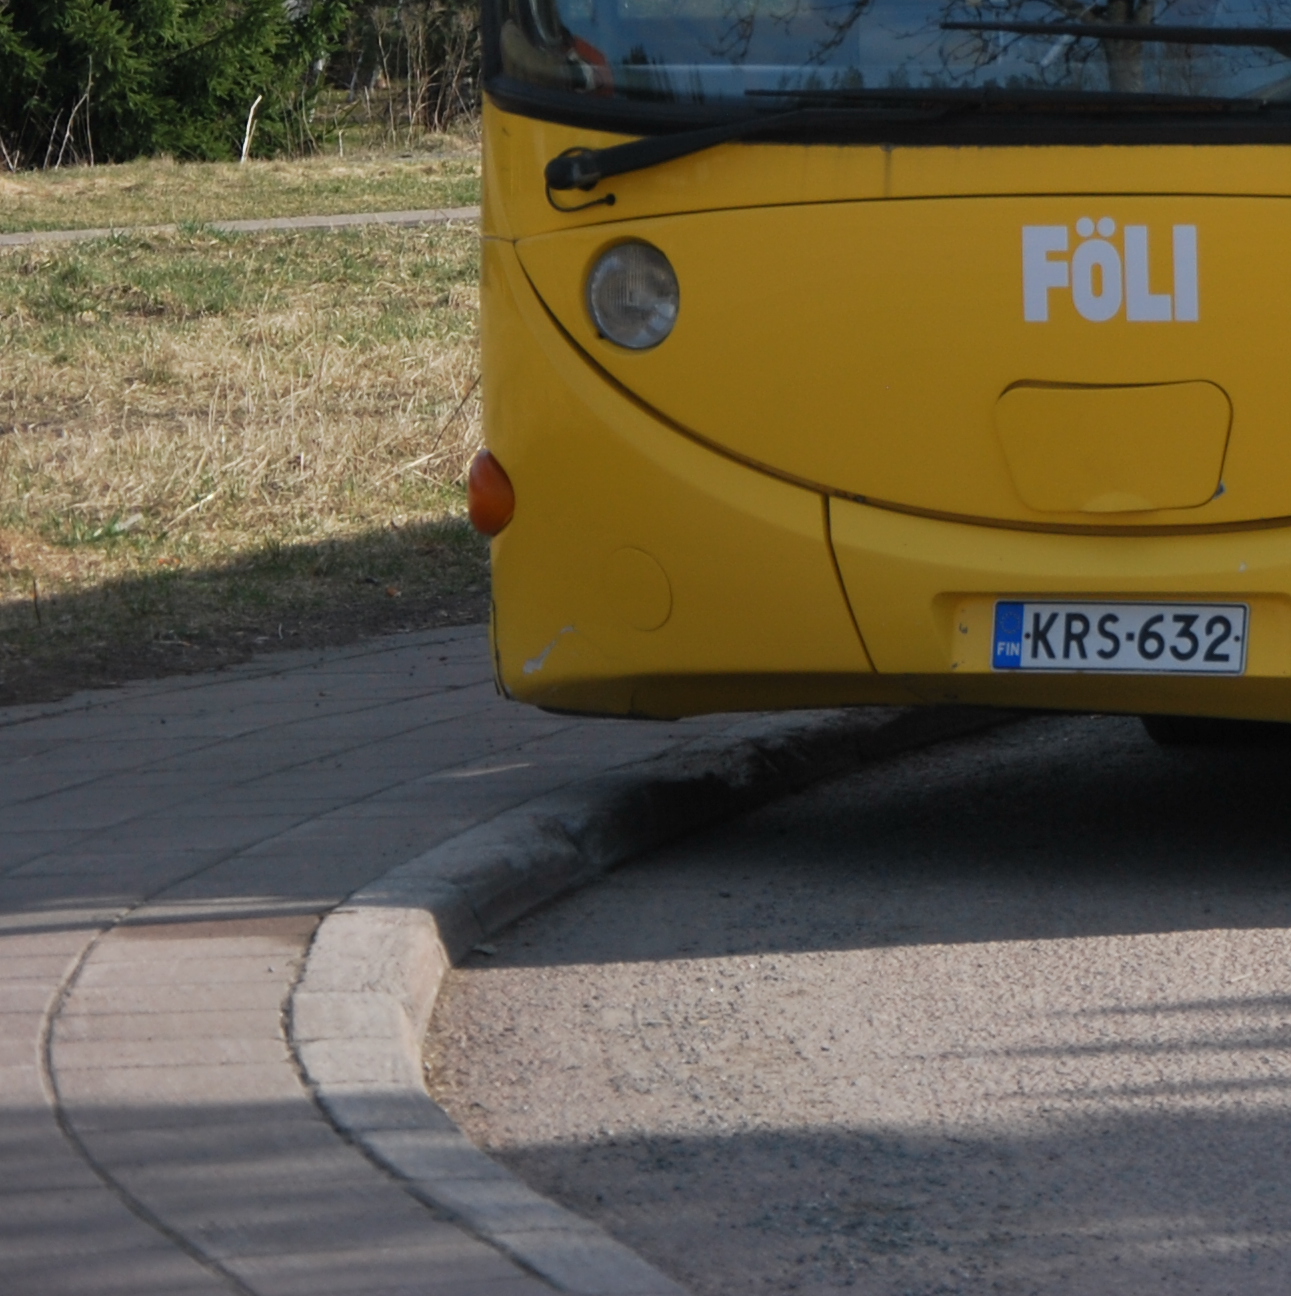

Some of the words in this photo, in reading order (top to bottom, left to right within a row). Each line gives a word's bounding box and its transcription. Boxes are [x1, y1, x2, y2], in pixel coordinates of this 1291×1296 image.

[1020, 215, 1200, 323] FÖLI
[997, 641, 1020, 656] FIN
[1030, 611, 1232, 663] KRS-632
